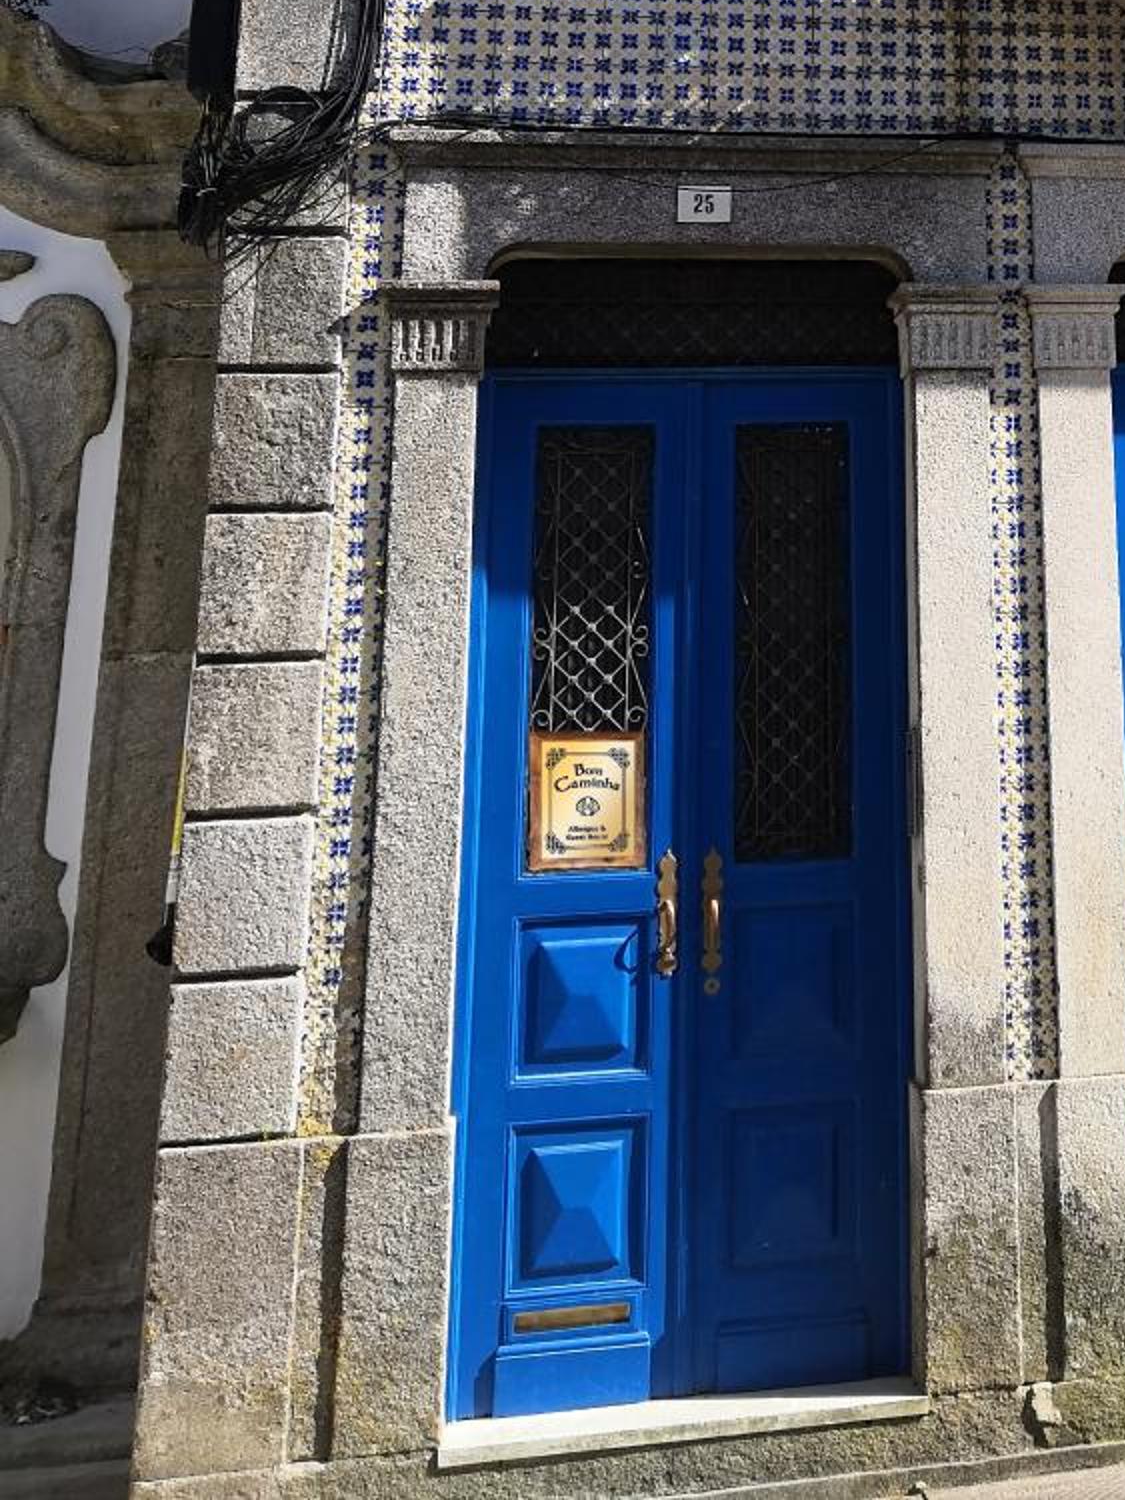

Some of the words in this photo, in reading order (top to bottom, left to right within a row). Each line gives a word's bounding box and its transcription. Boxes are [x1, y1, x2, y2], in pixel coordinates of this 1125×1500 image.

[693, 194, 714, 214] 25
[574, 763, 603, 776] Bom
[554, 776, 620, 792] Caminha
